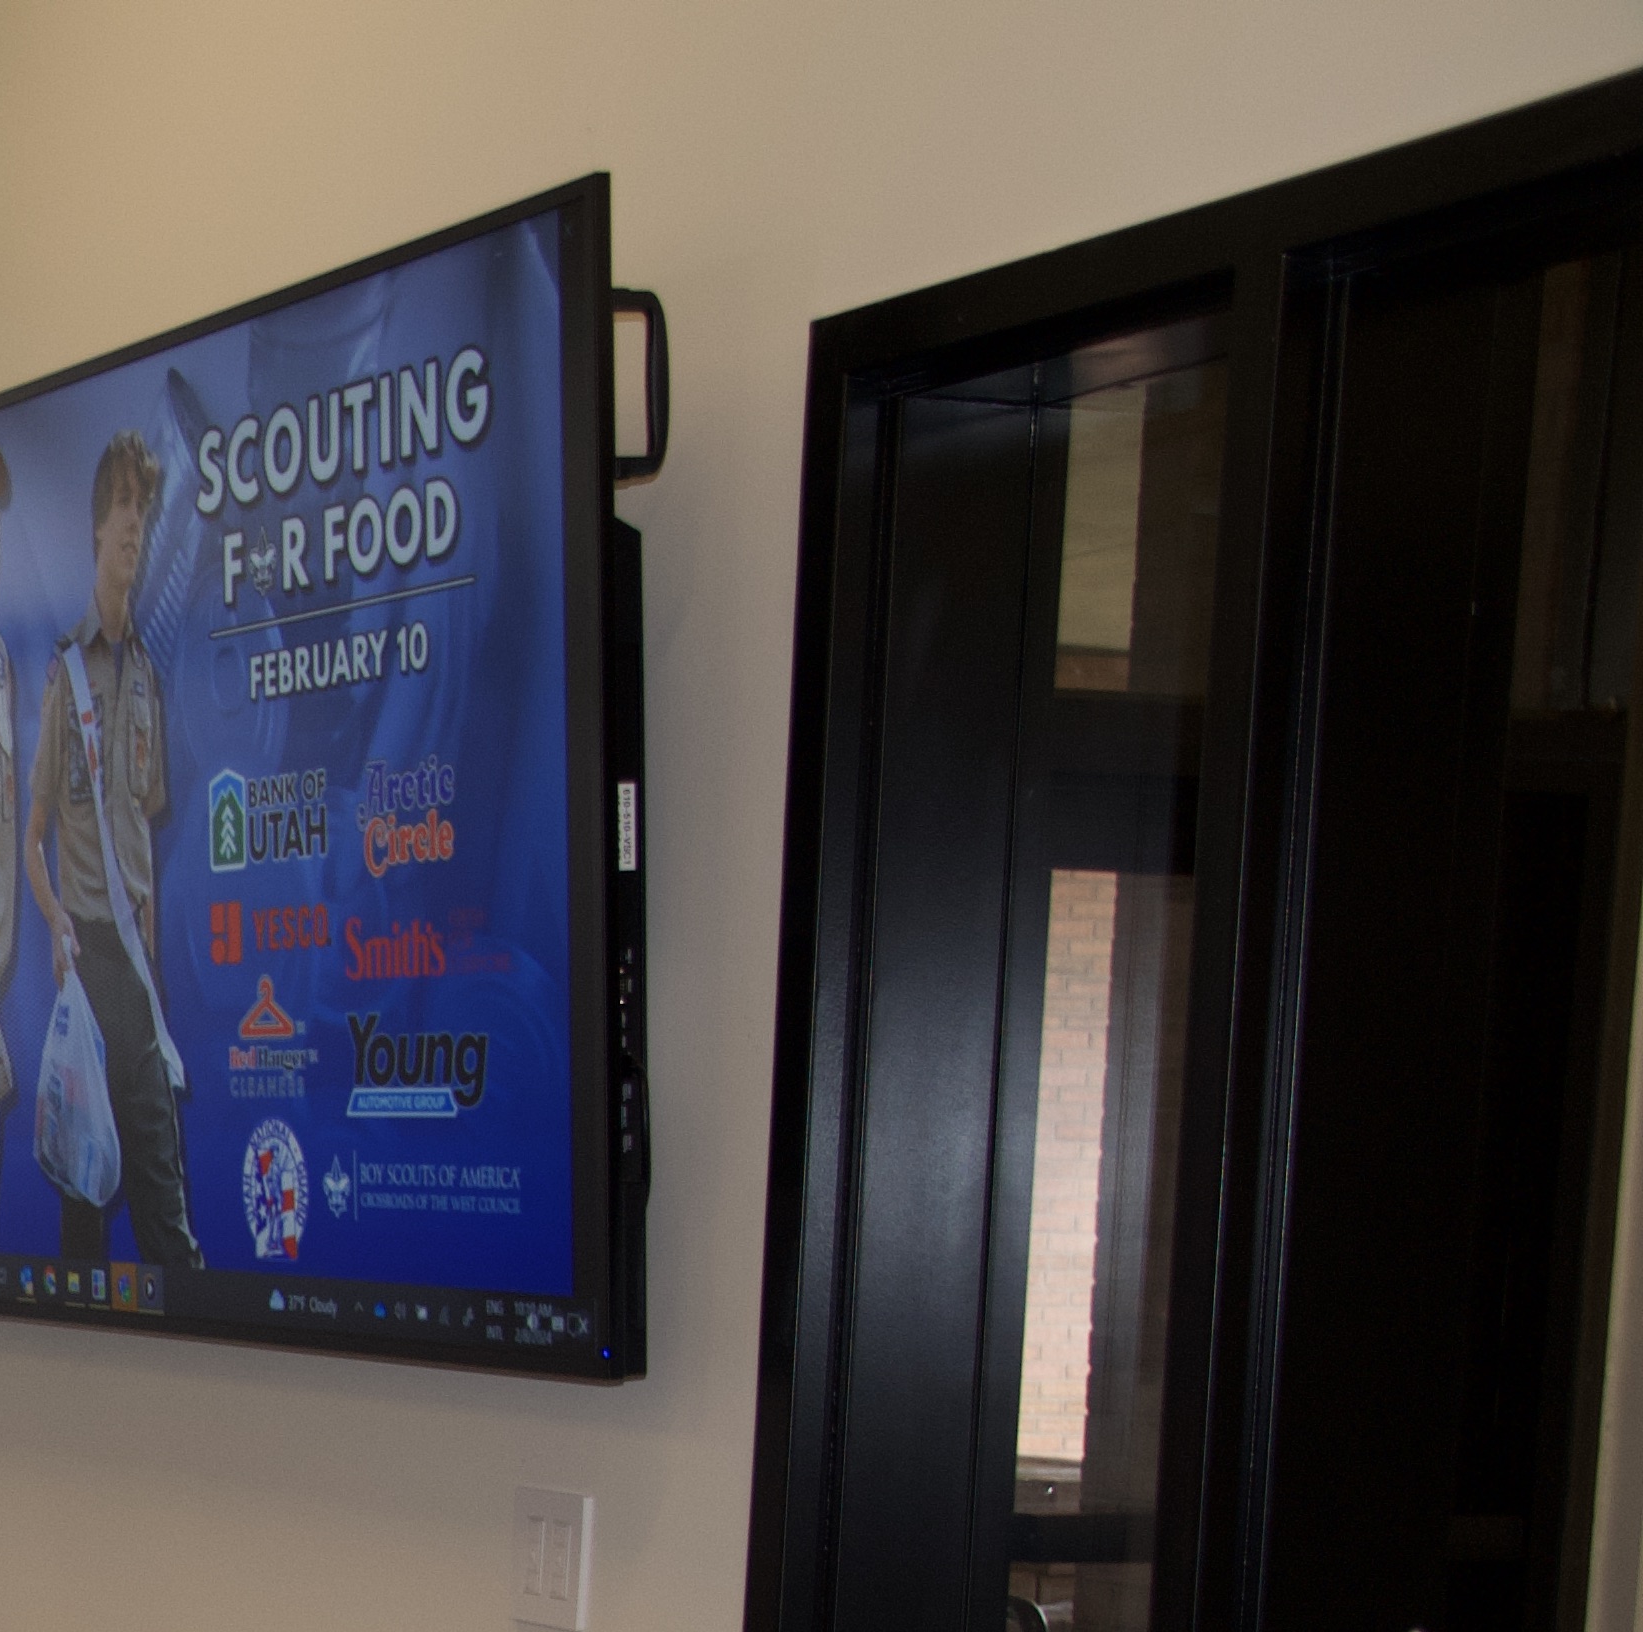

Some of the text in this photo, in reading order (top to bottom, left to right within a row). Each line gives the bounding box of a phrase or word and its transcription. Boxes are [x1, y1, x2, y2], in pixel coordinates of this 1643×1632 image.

[197, 348, 489, 514] SCOUTING
[223, 479, 457, 605] FR FOOD
[250, 621, 428, 700] FEBRUARY 10
[247, 768, 327, 809] BANK OF
[362, 755, 455, 815] Arctic
[248, 805, 328, 863] UTAH
[365, 808, 455, 878] Circle
[252, 902, 330, 951] YESCO
[344, 916, 446, 982] Smith's
[347, 1012, 489, 1108] Young
[357, 1095, 446, 1110] AUTOMOTIVE GROUP
[359, 1162, 521, 1190] BOY SCOUTS OF AMERICA
[416, 1193, 428, 1210] OF
[431, 1194, 448, 1211] THE
[451, 1195, 476, 1212] WEST
[478, 1196, 521, 1214] COUNCIL
[309, 1296, 338, 1320] Cloudy
